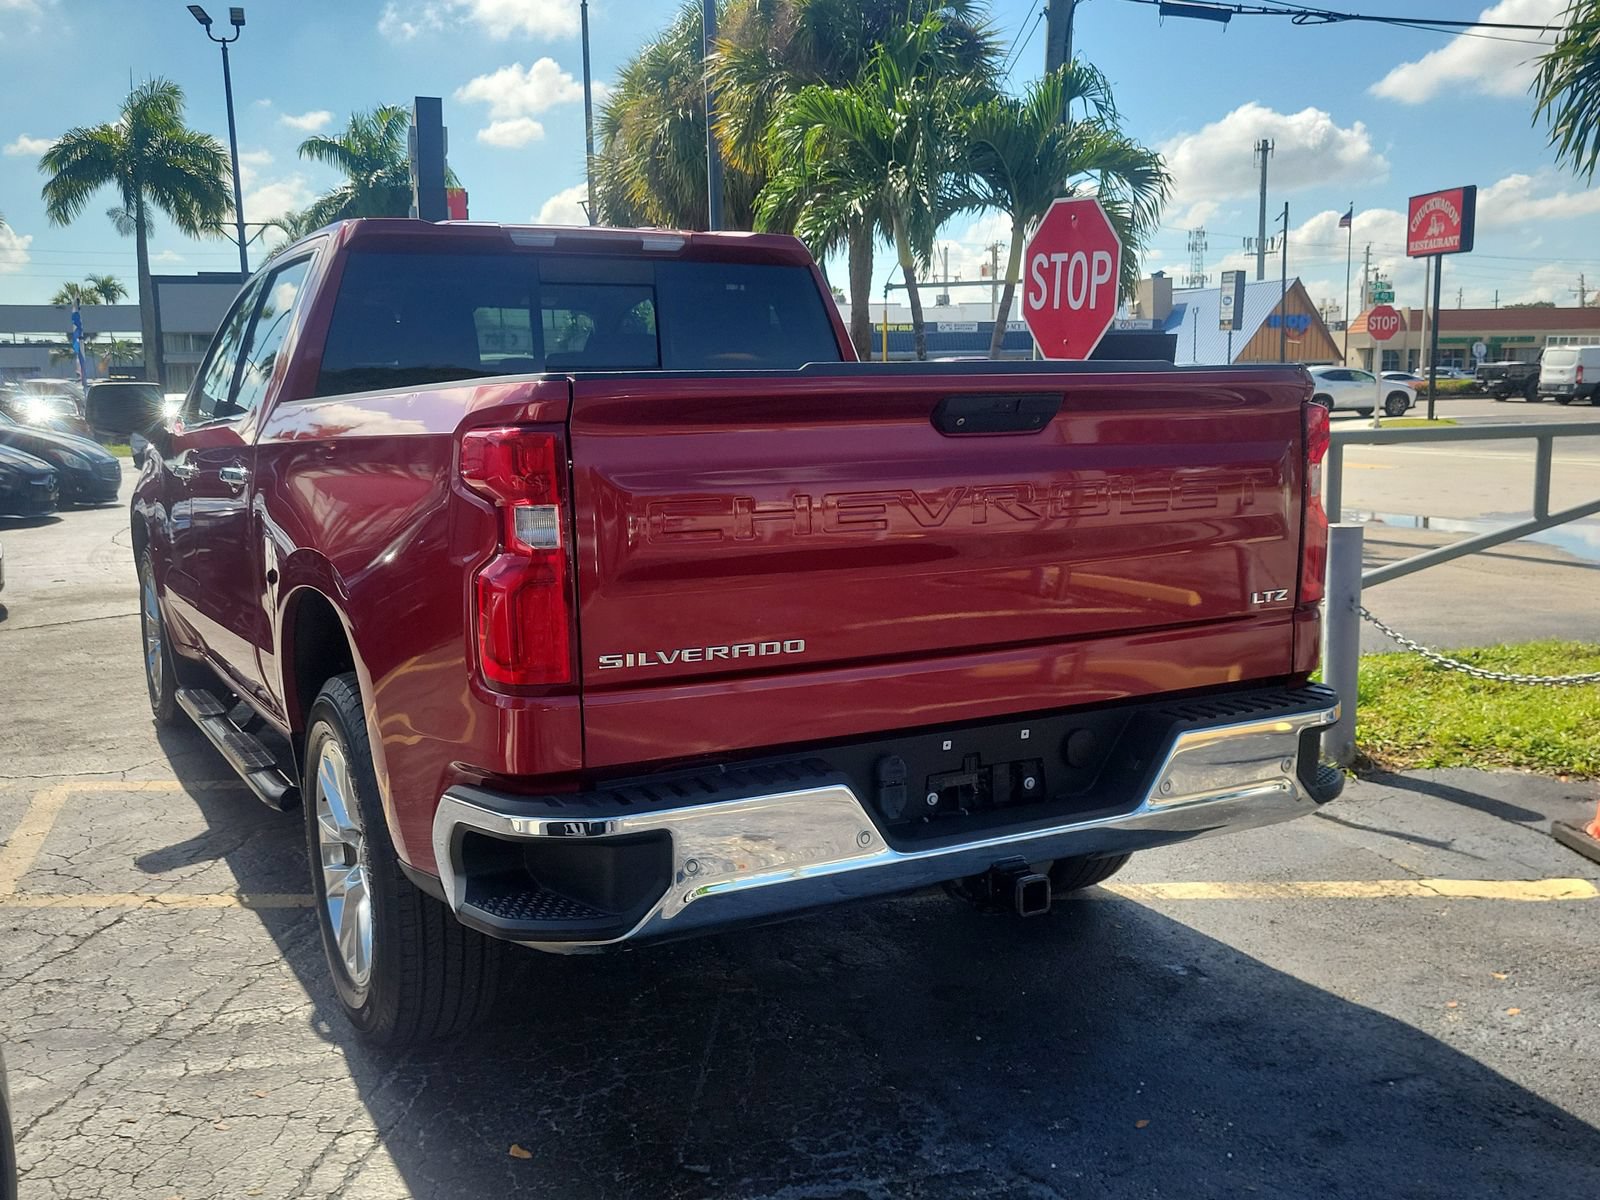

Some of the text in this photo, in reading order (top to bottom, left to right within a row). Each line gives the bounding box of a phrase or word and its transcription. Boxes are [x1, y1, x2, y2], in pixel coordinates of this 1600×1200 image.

[1410, 197, 1460, 232] CHUCKWAGON
[1409, 235, 1460, 252] RESTAURANT
[1029, 251, 1112, 310] STOP
[1369, 316, 1398, 330] STOP
[647, 468, 1273, 544] CHEVROLET
[1251, 589, 1288, 604] LTZ
[598, 639, 806, 669] SILVERADO
